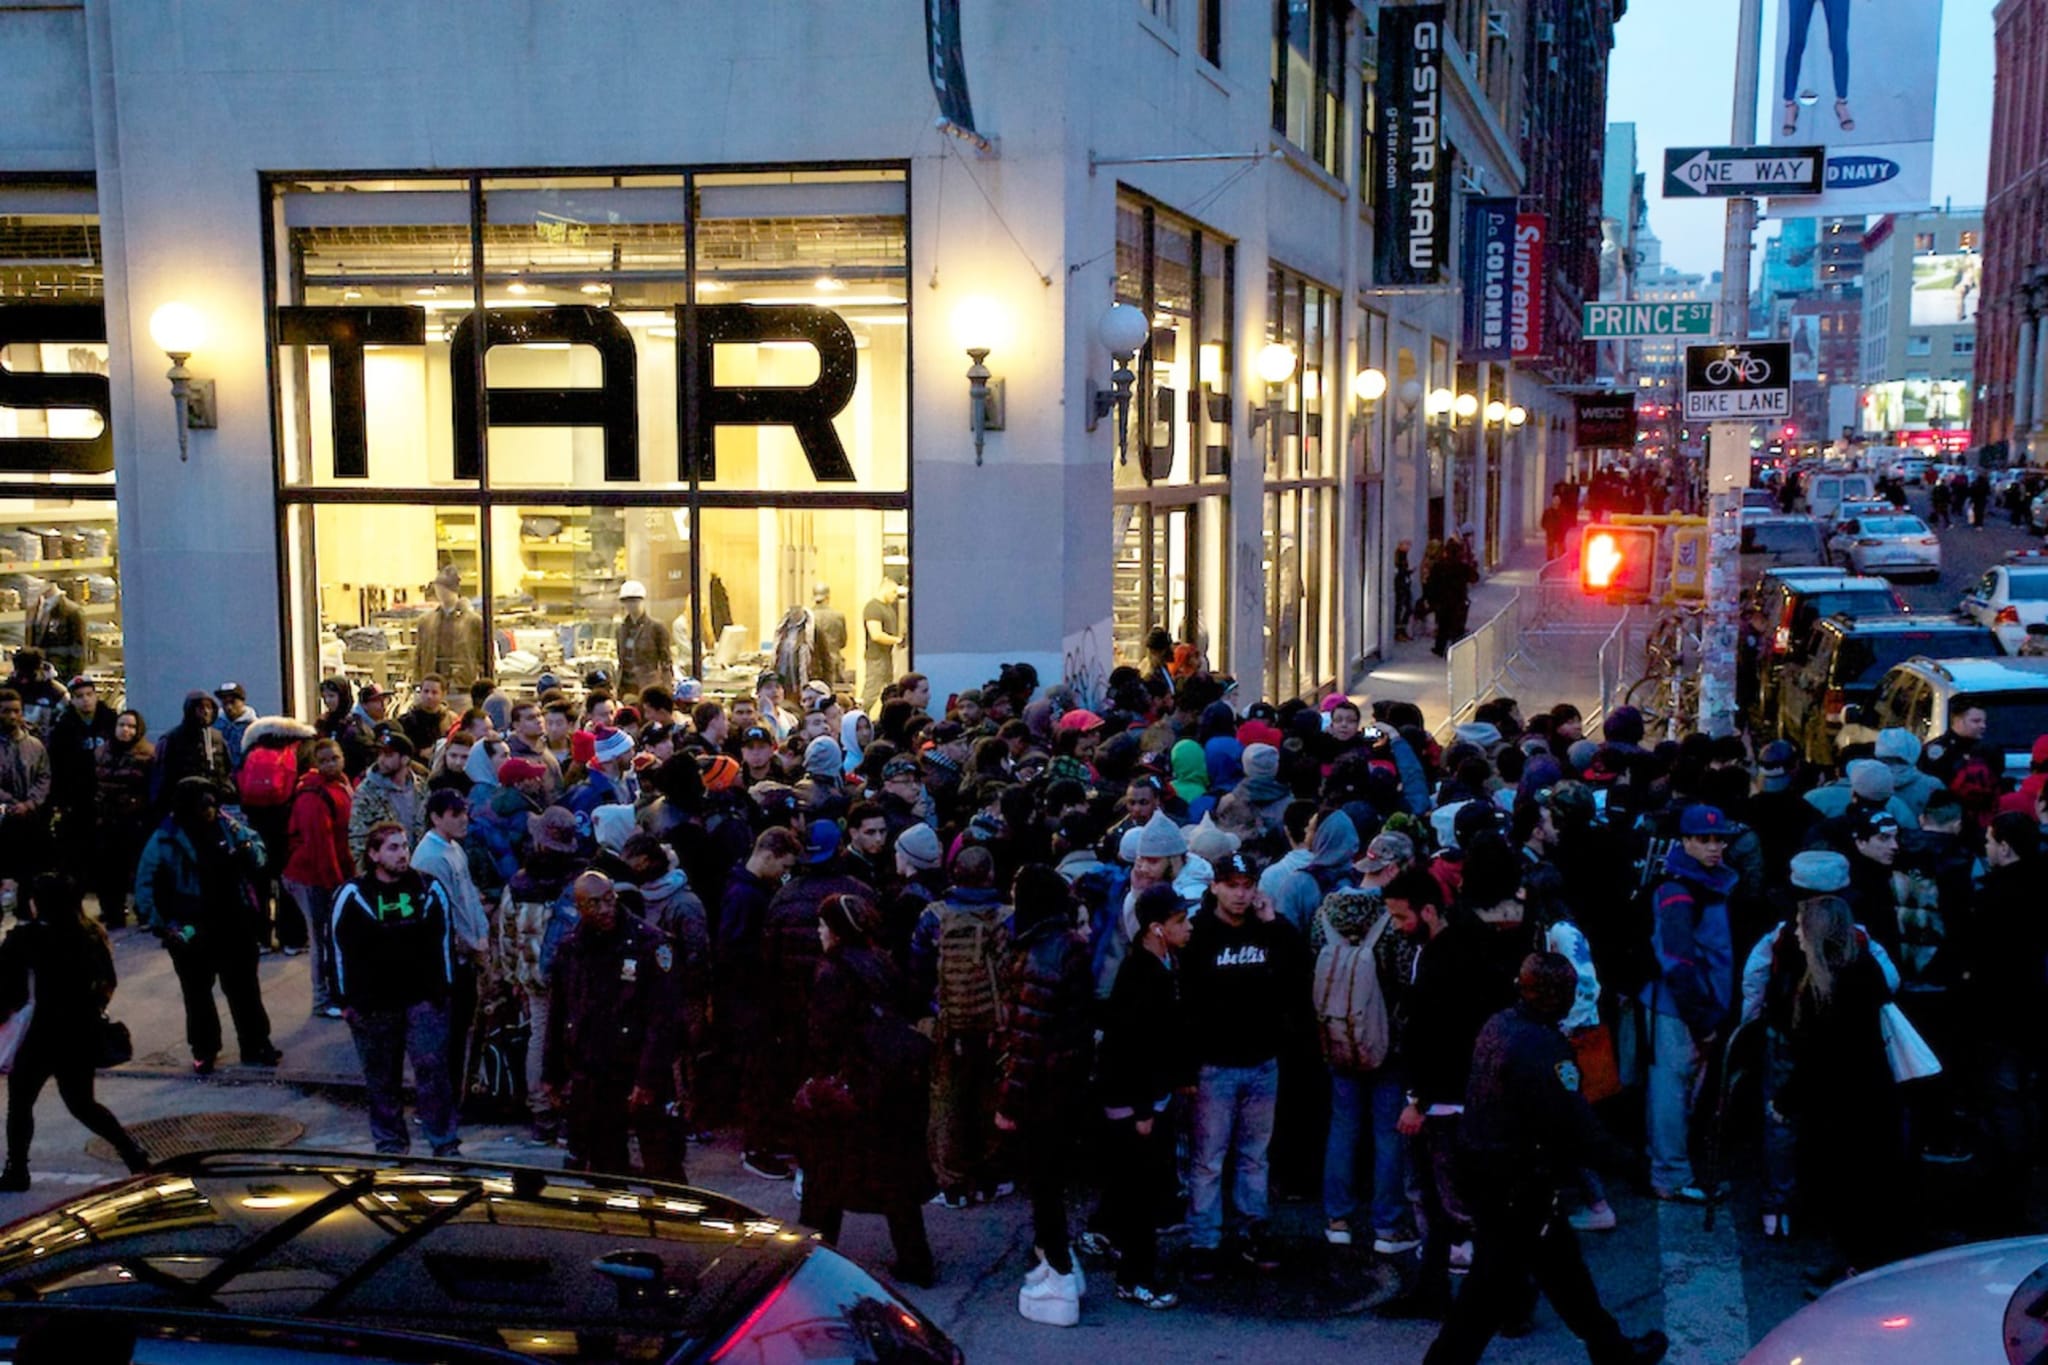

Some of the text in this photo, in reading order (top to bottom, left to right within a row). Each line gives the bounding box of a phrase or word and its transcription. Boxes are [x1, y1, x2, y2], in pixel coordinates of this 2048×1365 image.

[1386, 107, 1399, 189] g-star.com
[1409, 21, 1437, 269] G-STAR RAW
[1688, 162, 1733, 182] ONE
[1754, 160, 1804, 181] WAY
[1842, 163, 1891, 180] NAVY
[1483, 212, 1505, 349] La COLOMBE
[1511, 224, 1540, 351] Supreme
[1589, 304, 1710, 334] PRINCE ST
[1691, 392, 1785, 412] BIKE LANE
